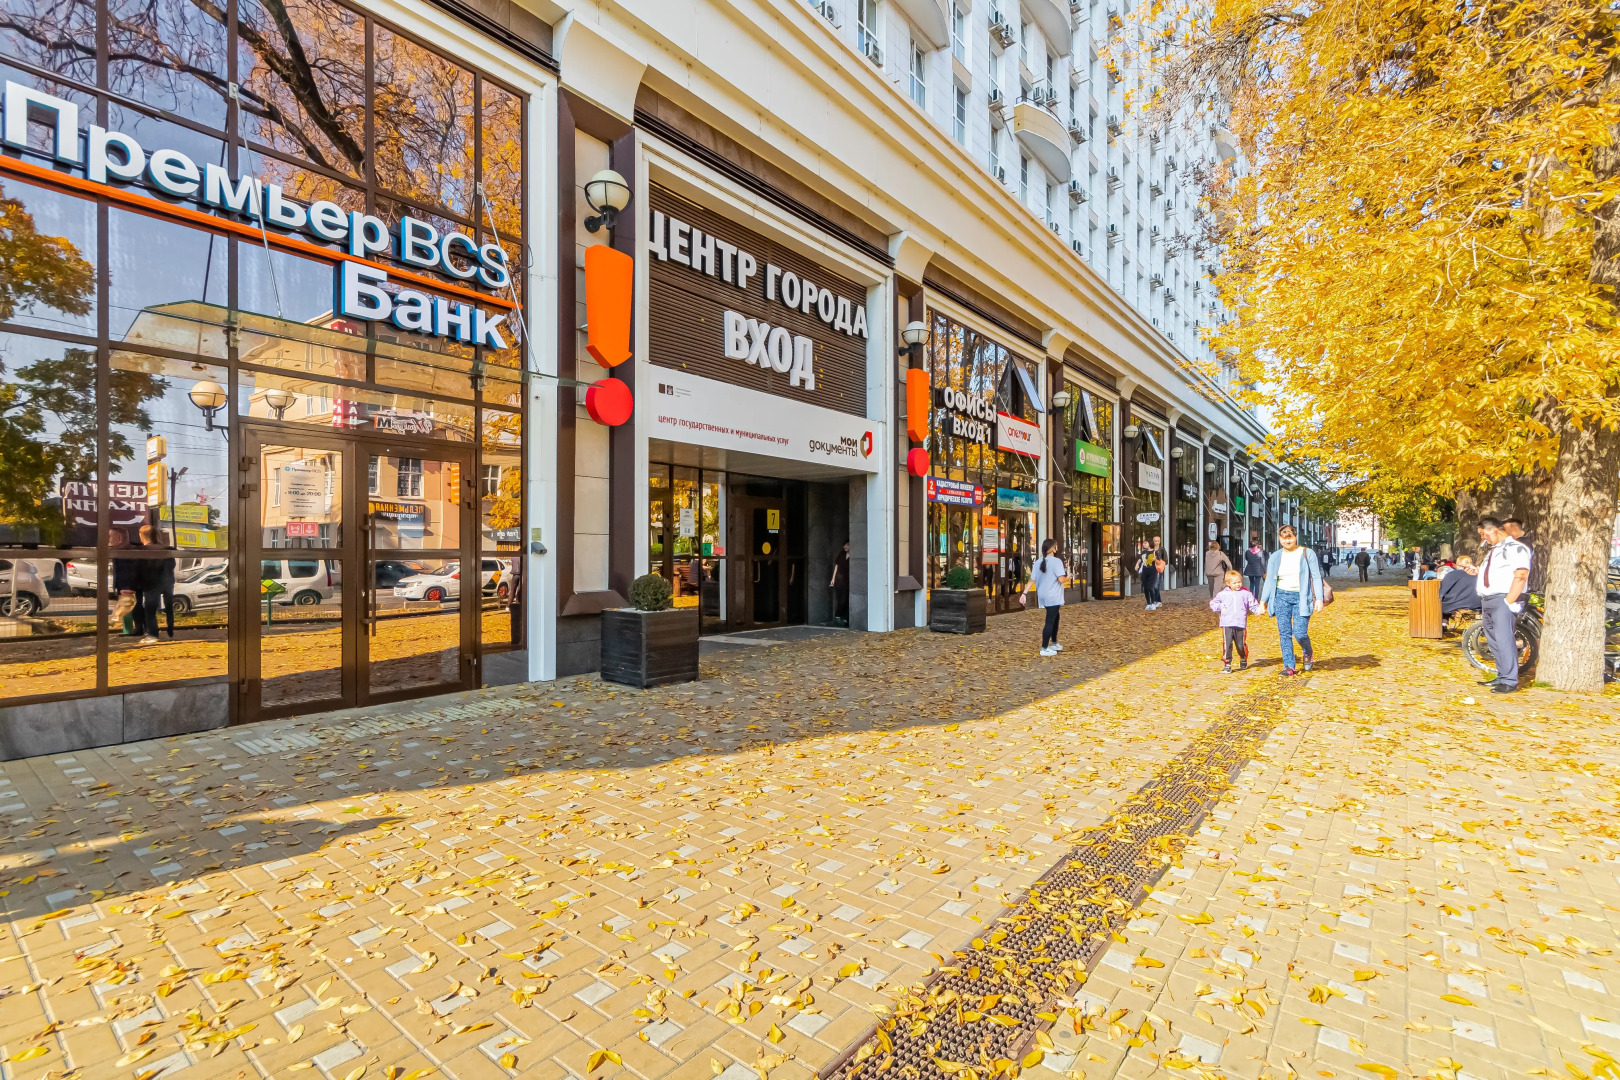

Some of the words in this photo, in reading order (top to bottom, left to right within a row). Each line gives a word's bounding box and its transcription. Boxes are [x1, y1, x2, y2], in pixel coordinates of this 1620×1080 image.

[3, 80, 390, 256] Премьер
[401, 215, 510, 289] BCS
[649, 208, 757, 289] ЦЕНТР
[766, 263, 869, 339] ГОРОДА
[338, 260, 508, 350] Банк
[724, 310, 815, 391] ВХОД
[944, 386, 997, 424] ОФИСЫ
[658, 414, 677, 427] центр
[679, 418, 729, 435] государственных
[735, 429, 776, 444] муниципальных
[777, 437, 790, 446] услуг
[840, 436, 858, 448] мои
[953, 415, 985, 445] ВХОД
[986, 428, 991, 444] 1
[809, 439, 858, 457] документы
[930, 480, 934, 490] 2
[771, 512, 776, 526] 7
